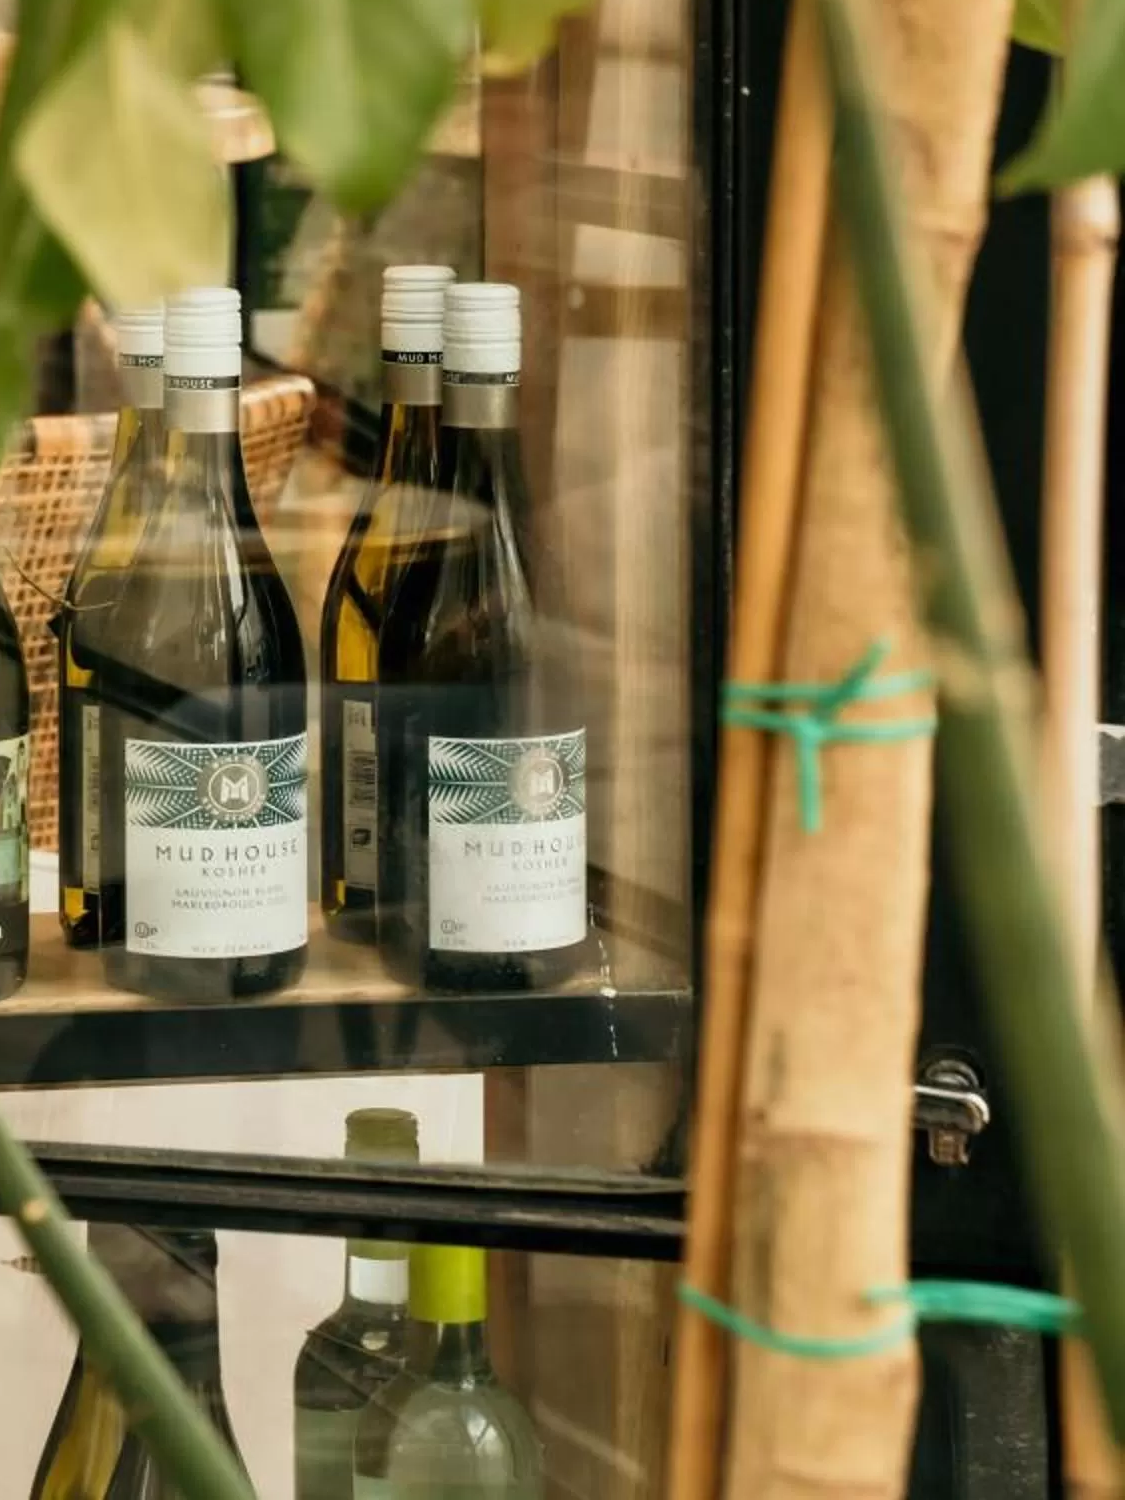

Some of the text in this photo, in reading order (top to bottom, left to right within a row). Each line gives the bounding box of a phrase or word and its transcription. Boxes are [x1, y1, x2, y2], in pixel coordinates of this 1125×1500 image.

[397, 353, 425, 363] MUD
[155, 838, 298, 863] MUD HOUSE
[464, 835, 576, 856] MUD HOU
